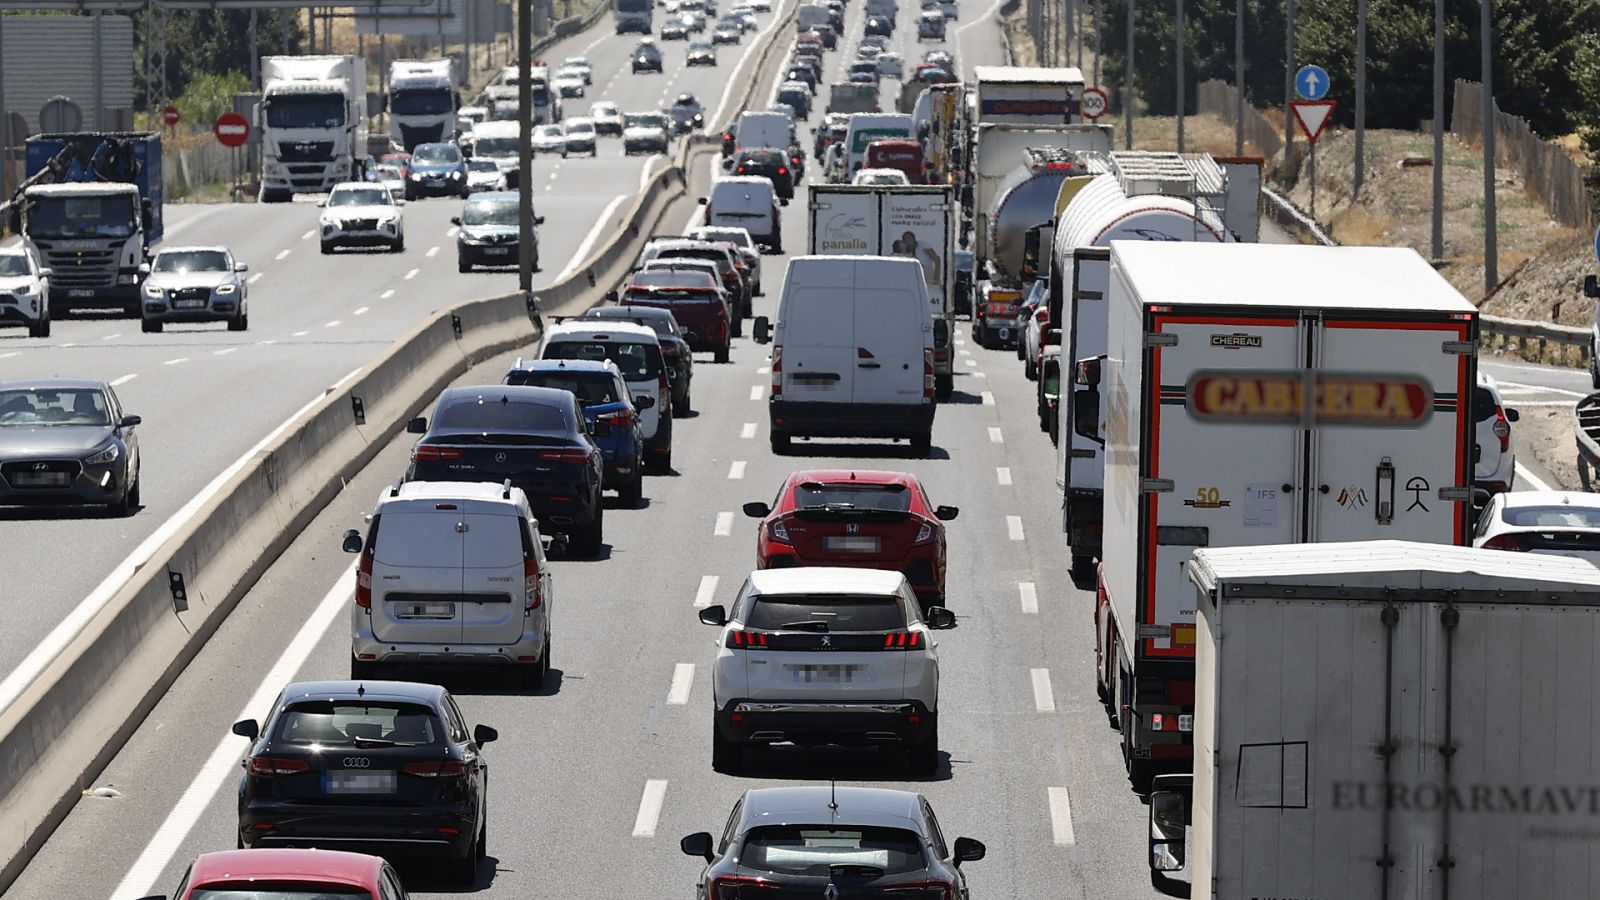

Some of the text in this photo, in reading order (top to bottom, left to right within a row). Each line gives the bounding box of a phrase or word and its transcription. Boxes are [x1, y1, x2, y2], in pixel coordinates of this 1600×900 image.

[1211, 336, 1261, 346] CHEREAU
[1196, 486, 1220, 503] 50
[1257, 489, 1276, 500] IFS
